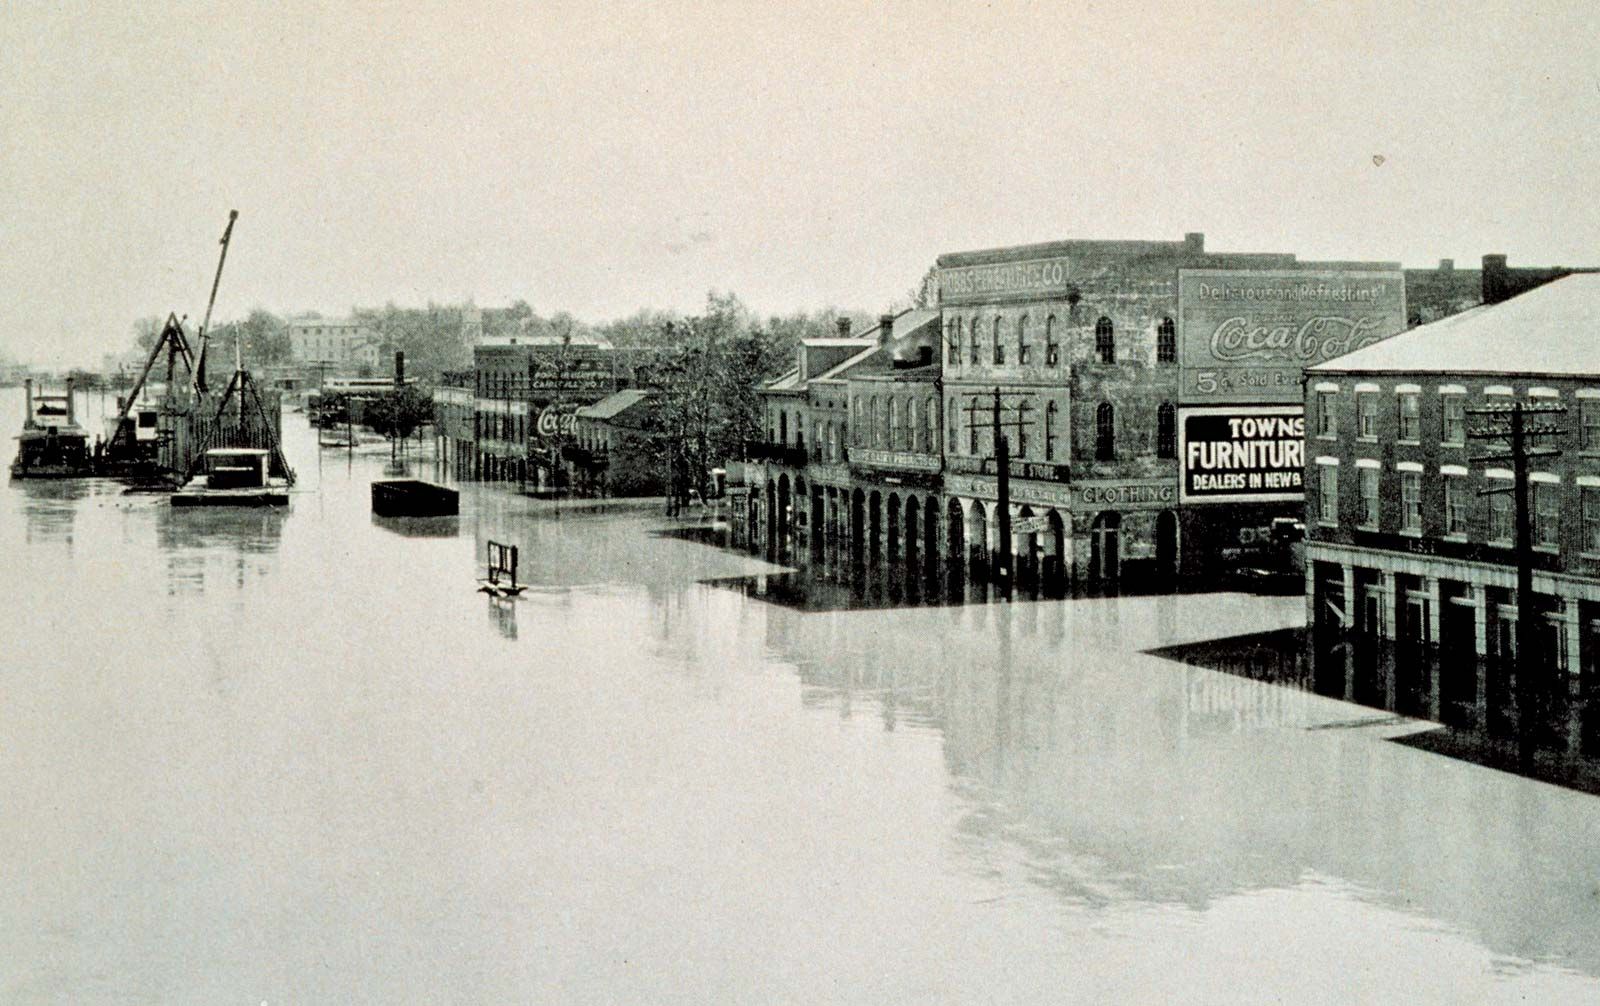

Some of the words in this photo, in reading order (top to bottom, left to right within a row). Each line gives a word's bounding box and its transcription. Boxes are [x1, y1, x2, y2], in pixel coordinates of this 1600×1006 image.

[1240, 373, 1267, 385] Sold
[1228, 417, 1304, 438] TOWNS
[1193, 473, 1246, 490] DEALERS
[1249, 473, 1262, 488] IN
[1265, 472, 1292, 488] NEW
[1083, 485, 1172, 503] CLOTHING
